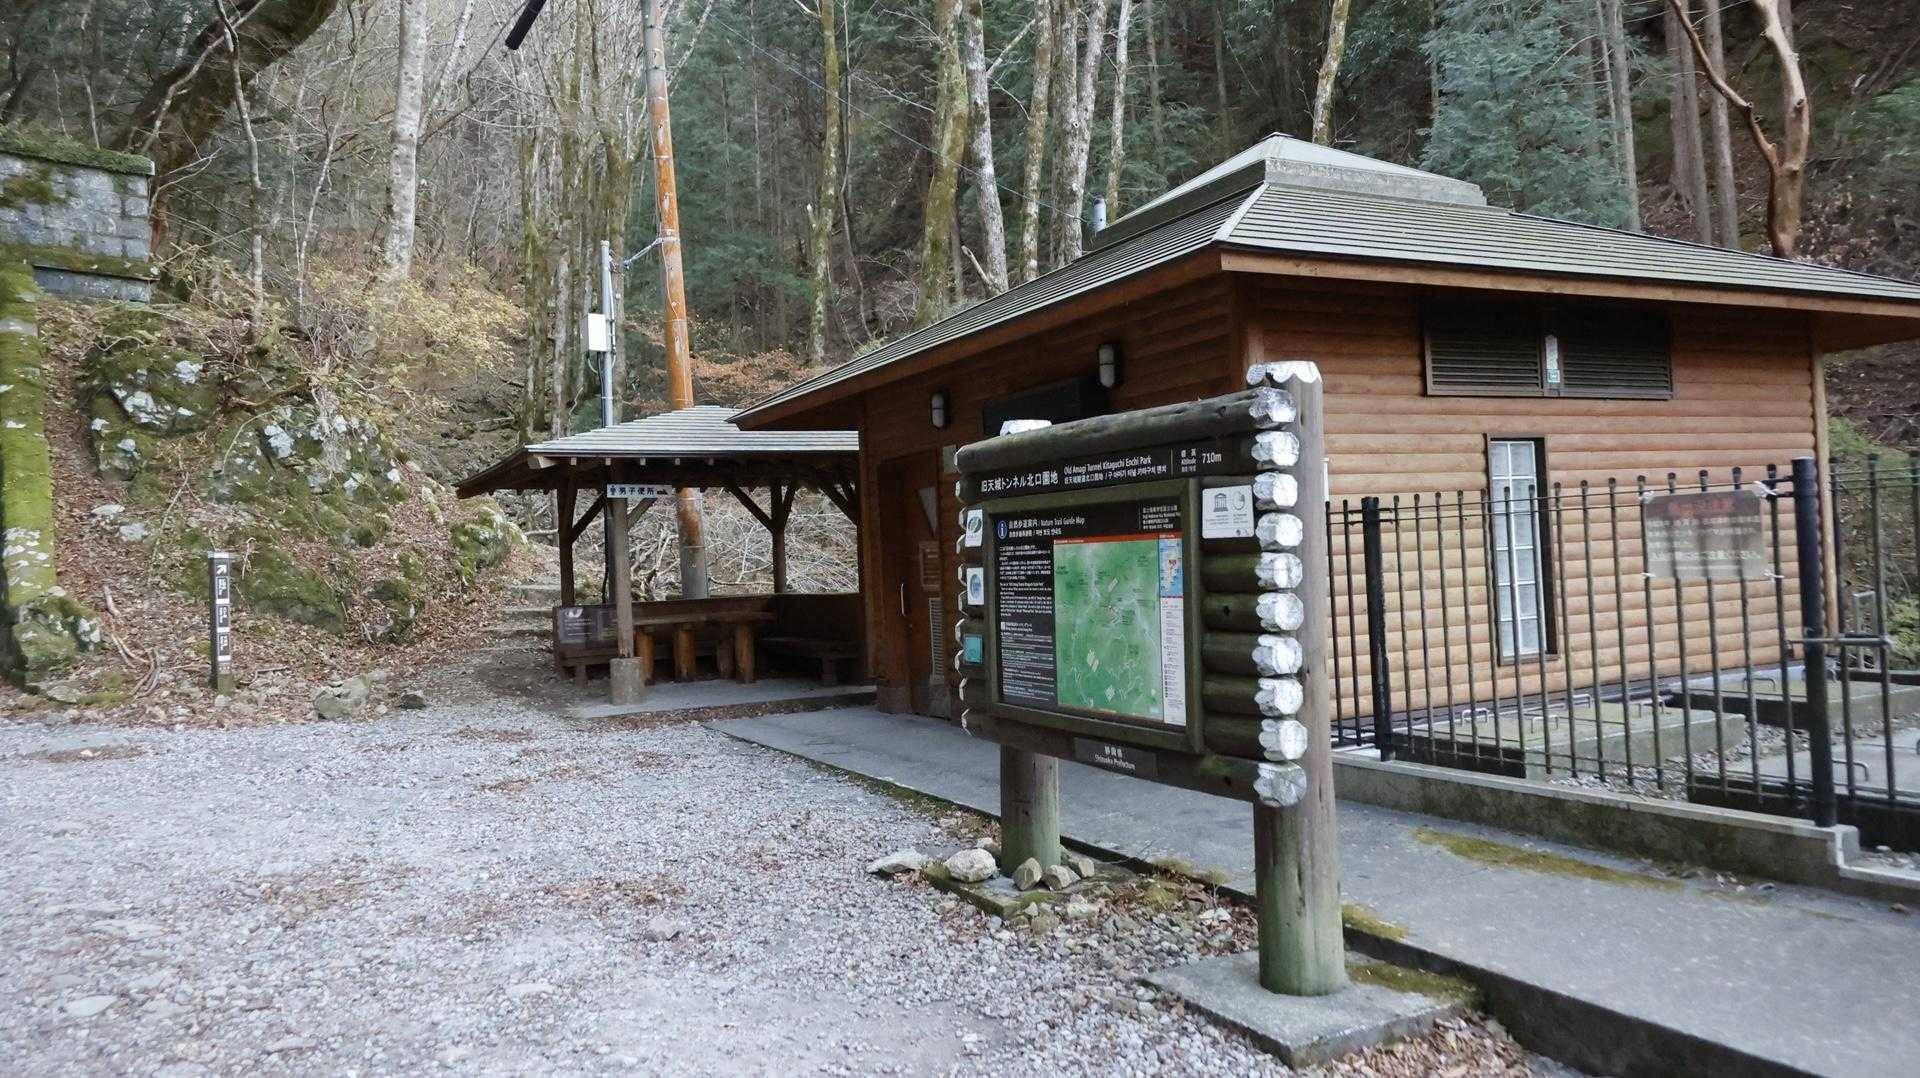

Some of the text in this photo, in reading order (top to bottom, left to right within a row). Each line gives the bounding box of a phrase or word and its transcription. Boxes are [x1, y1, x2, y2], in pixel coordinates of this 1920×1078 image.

[1202, 452, 1222, 464] 710m
[1063, 465, 1073, 475] Old
[1073, 464, 1087, 475] Amagi
[1087, 462, 1102, 472] Tunnel
[1103, 458, 1125, 471] Kitaguchi
[1140, 455, 1152, 465] Park
[1075, 516, 1085, 525] Map
